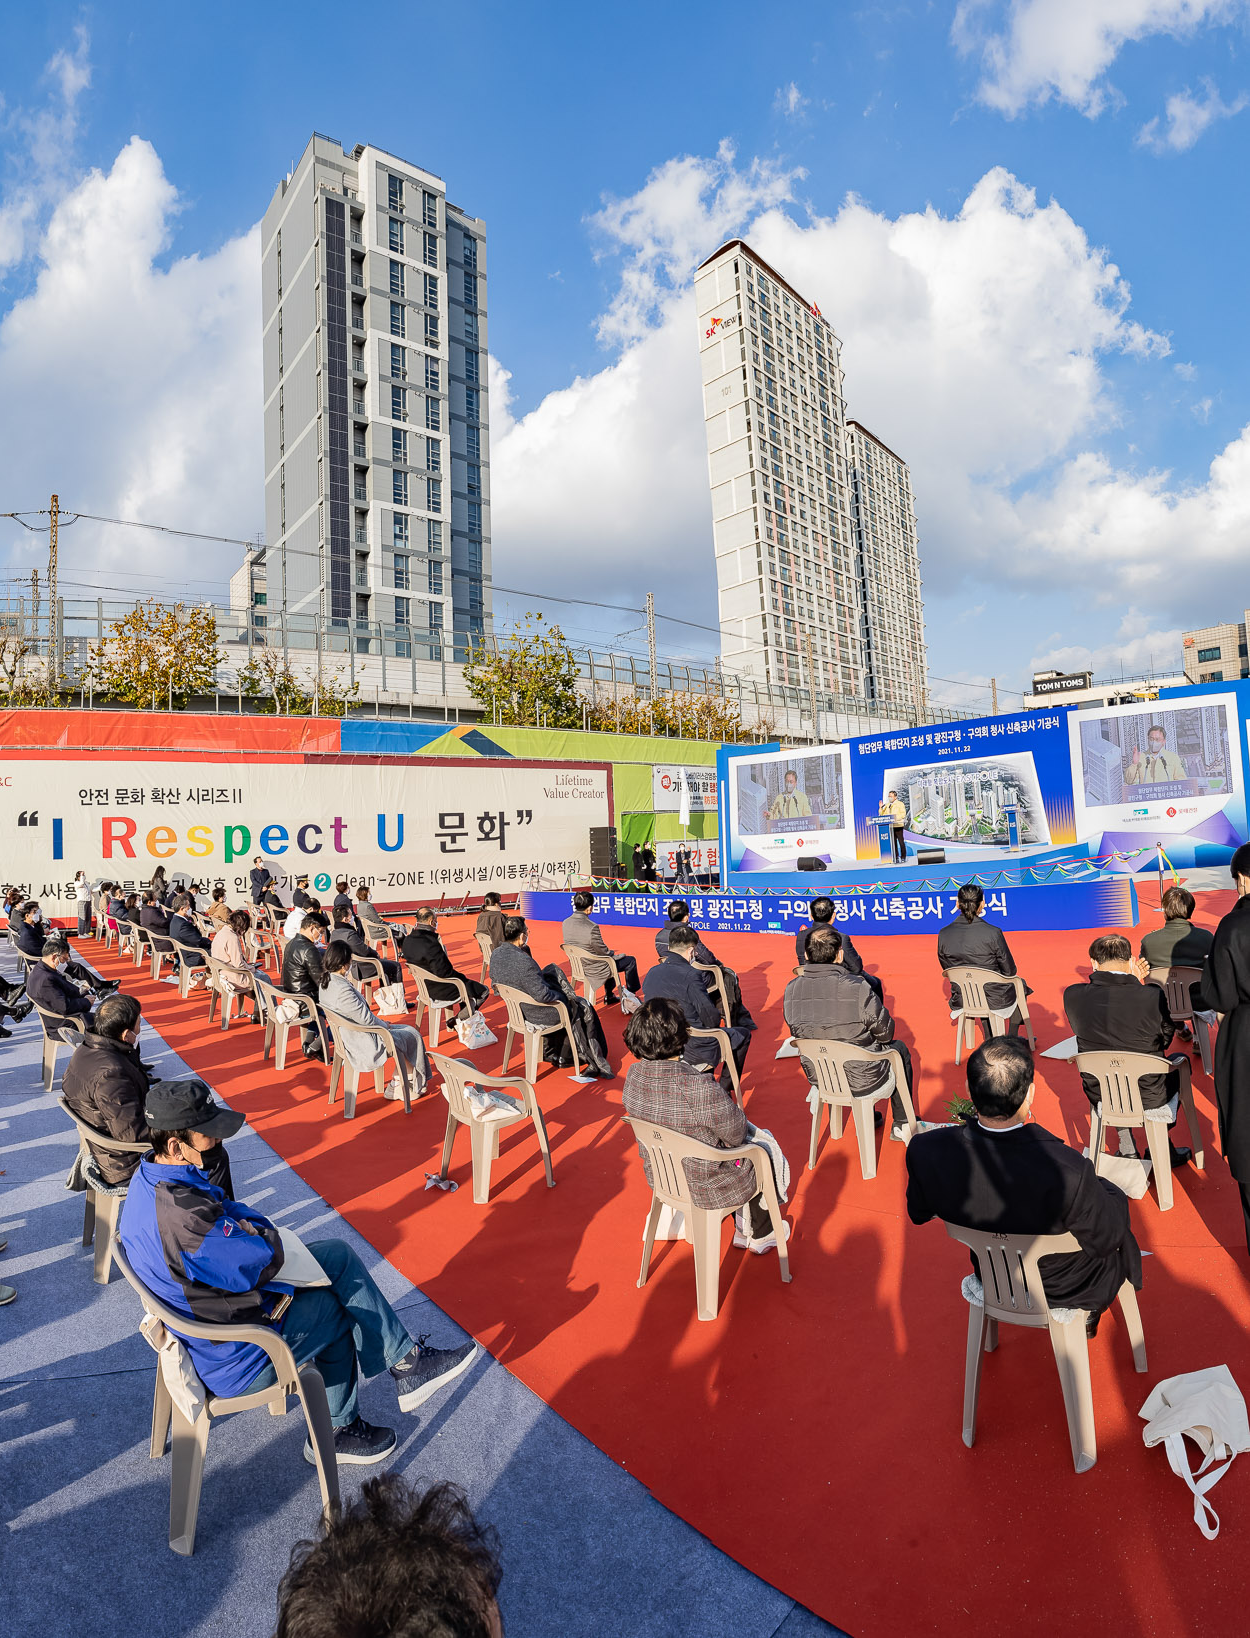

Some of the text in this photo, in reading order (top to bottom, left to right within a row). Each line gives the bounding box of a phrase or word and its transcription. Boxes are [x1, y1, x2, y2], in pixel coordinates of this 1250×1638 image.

[706, 315, 737, 339] SK VIEW
[722, 385, 732, 397] 101
[1036, 683, 1054, 691] TOM
[1061, 678, 1084, 688] TOMS
[858, 741, 883, 755] 첨단업무
[884, 737, 910, 750] 복합단지
[911, 735, 924, 747] 조성
[925, 734, 933, 745] 및
[934, 730, 961, 744] 광진구청
[967, 725, 989, 739] 구의회
[990, 723, 1005, 736] 청사
[1006, 720, 1036, 734] 신축공사
[1037, 716, 1060, 730] 기공식
[555, 774, 593, 788] Lifetime
[78, 788, 110, 806] 안전
[114, 787, 146, 806] 문화
[150, 787, 181, 805] 확산
[543, 787, 605, 799] Value Creator
[101, 816, 349, 864] Respect
[376, 813, 404, 852] U
[613, 896, 659, 917] 복합단지
[690, 898, 705, 918] 및
[707, 898, 763, 920] 광진구청
[777, 899, 815, 922] 구의
[834, 898, 866, 922] 청사
[871, 896, 944, 921] 신축공사
